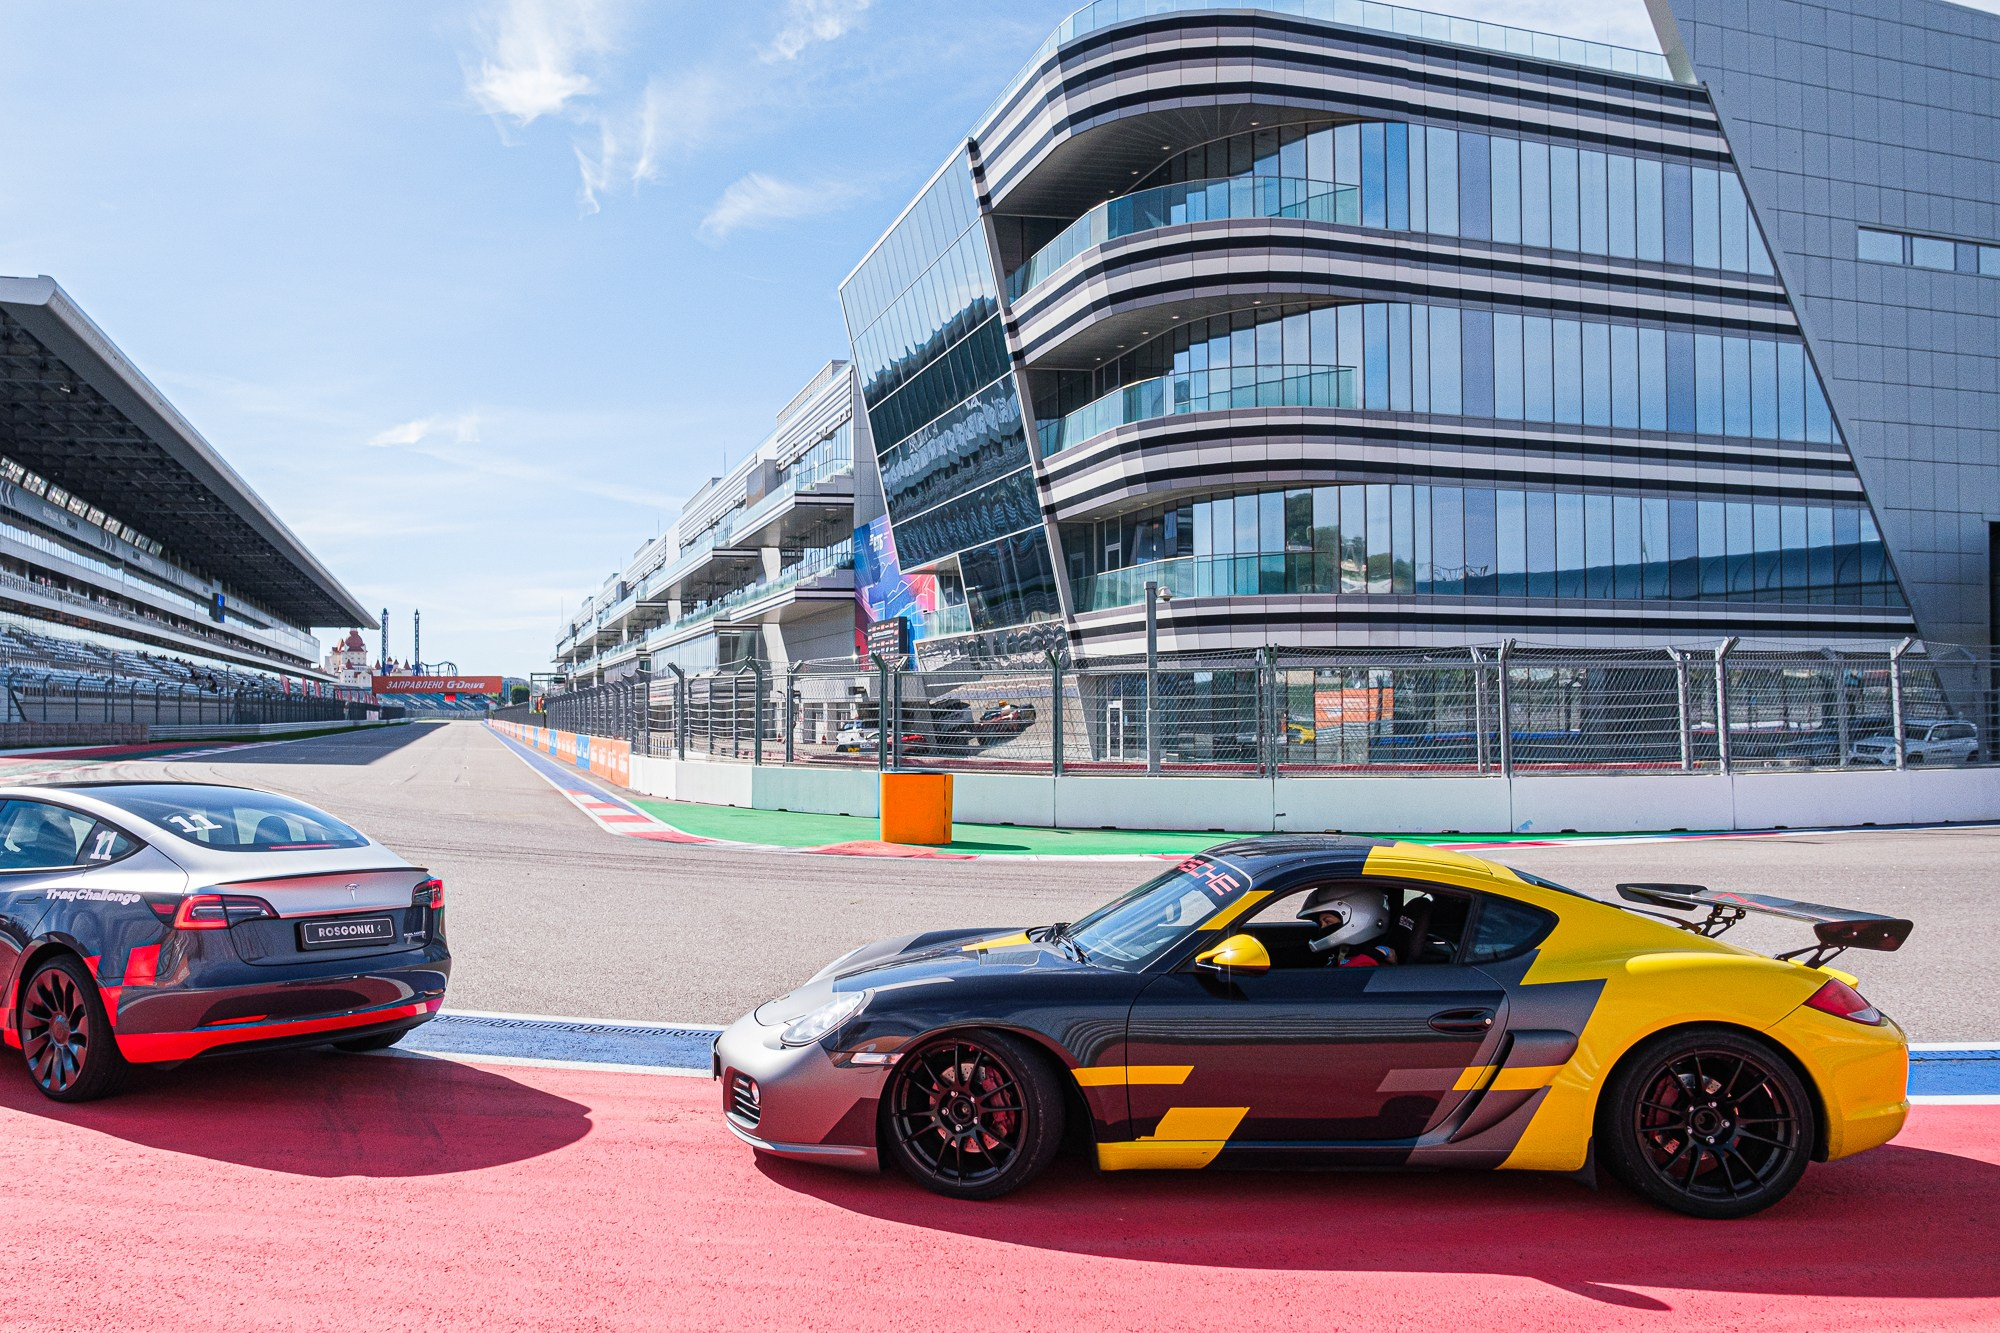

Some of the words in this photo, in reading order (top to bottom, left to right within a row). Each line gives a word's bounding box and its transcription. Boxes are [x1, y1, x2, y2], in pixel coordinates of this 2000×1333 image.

[386, 680, 444, 689] ЗАПРАВЛЕНО
[168, 814, 223, 833] 11
[89, 830, 118, 861] 11
[318, 924, 375, 938] ROSGONKI
